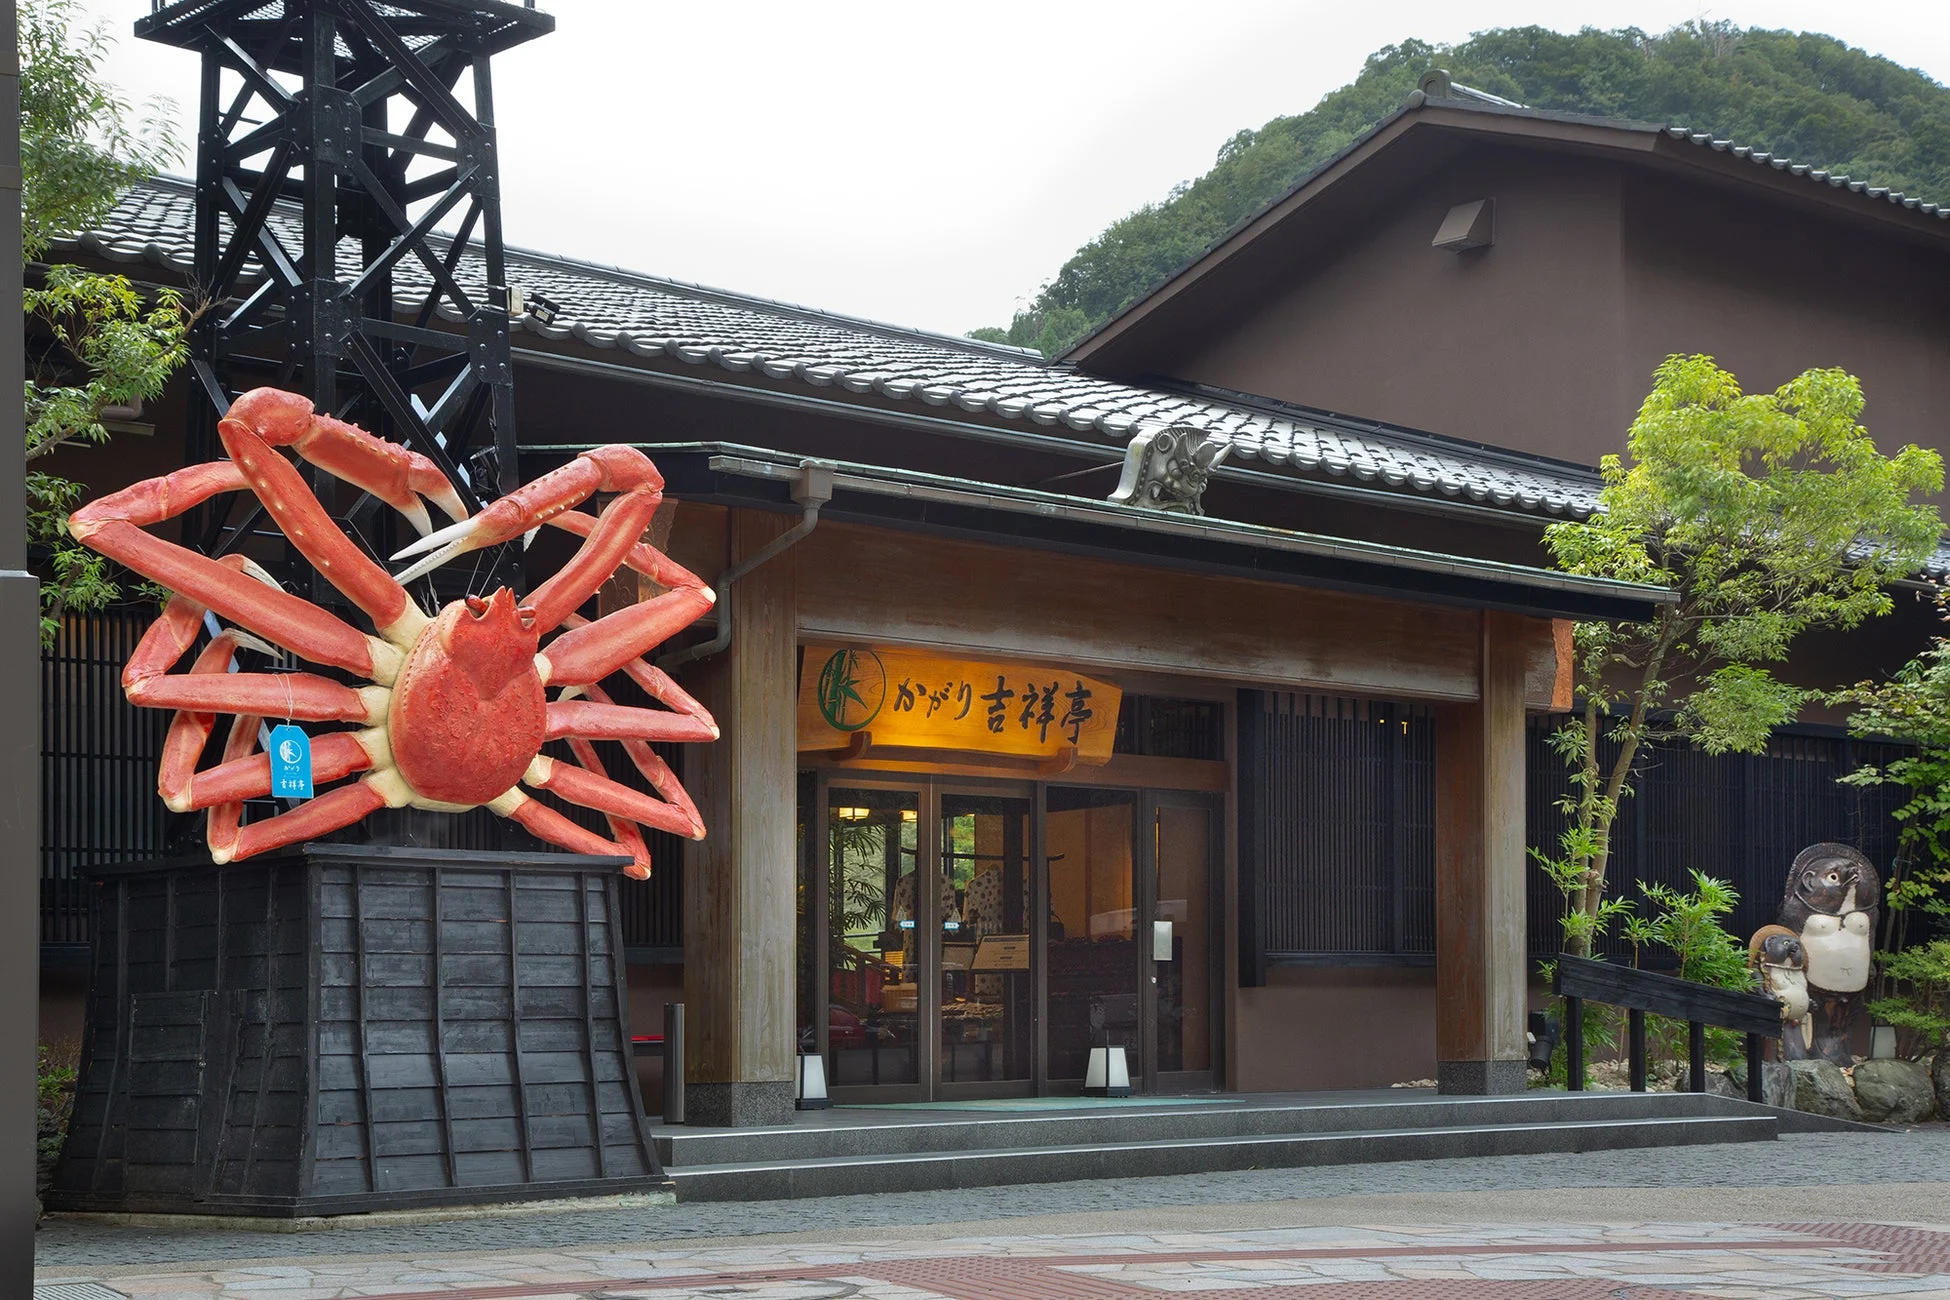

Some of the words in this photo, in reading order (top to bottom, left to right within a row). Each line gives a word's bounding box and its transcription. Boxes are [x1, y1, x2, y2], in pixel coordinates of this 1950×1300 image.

[894, 675, 1094, 744] かがり吉祥亭
